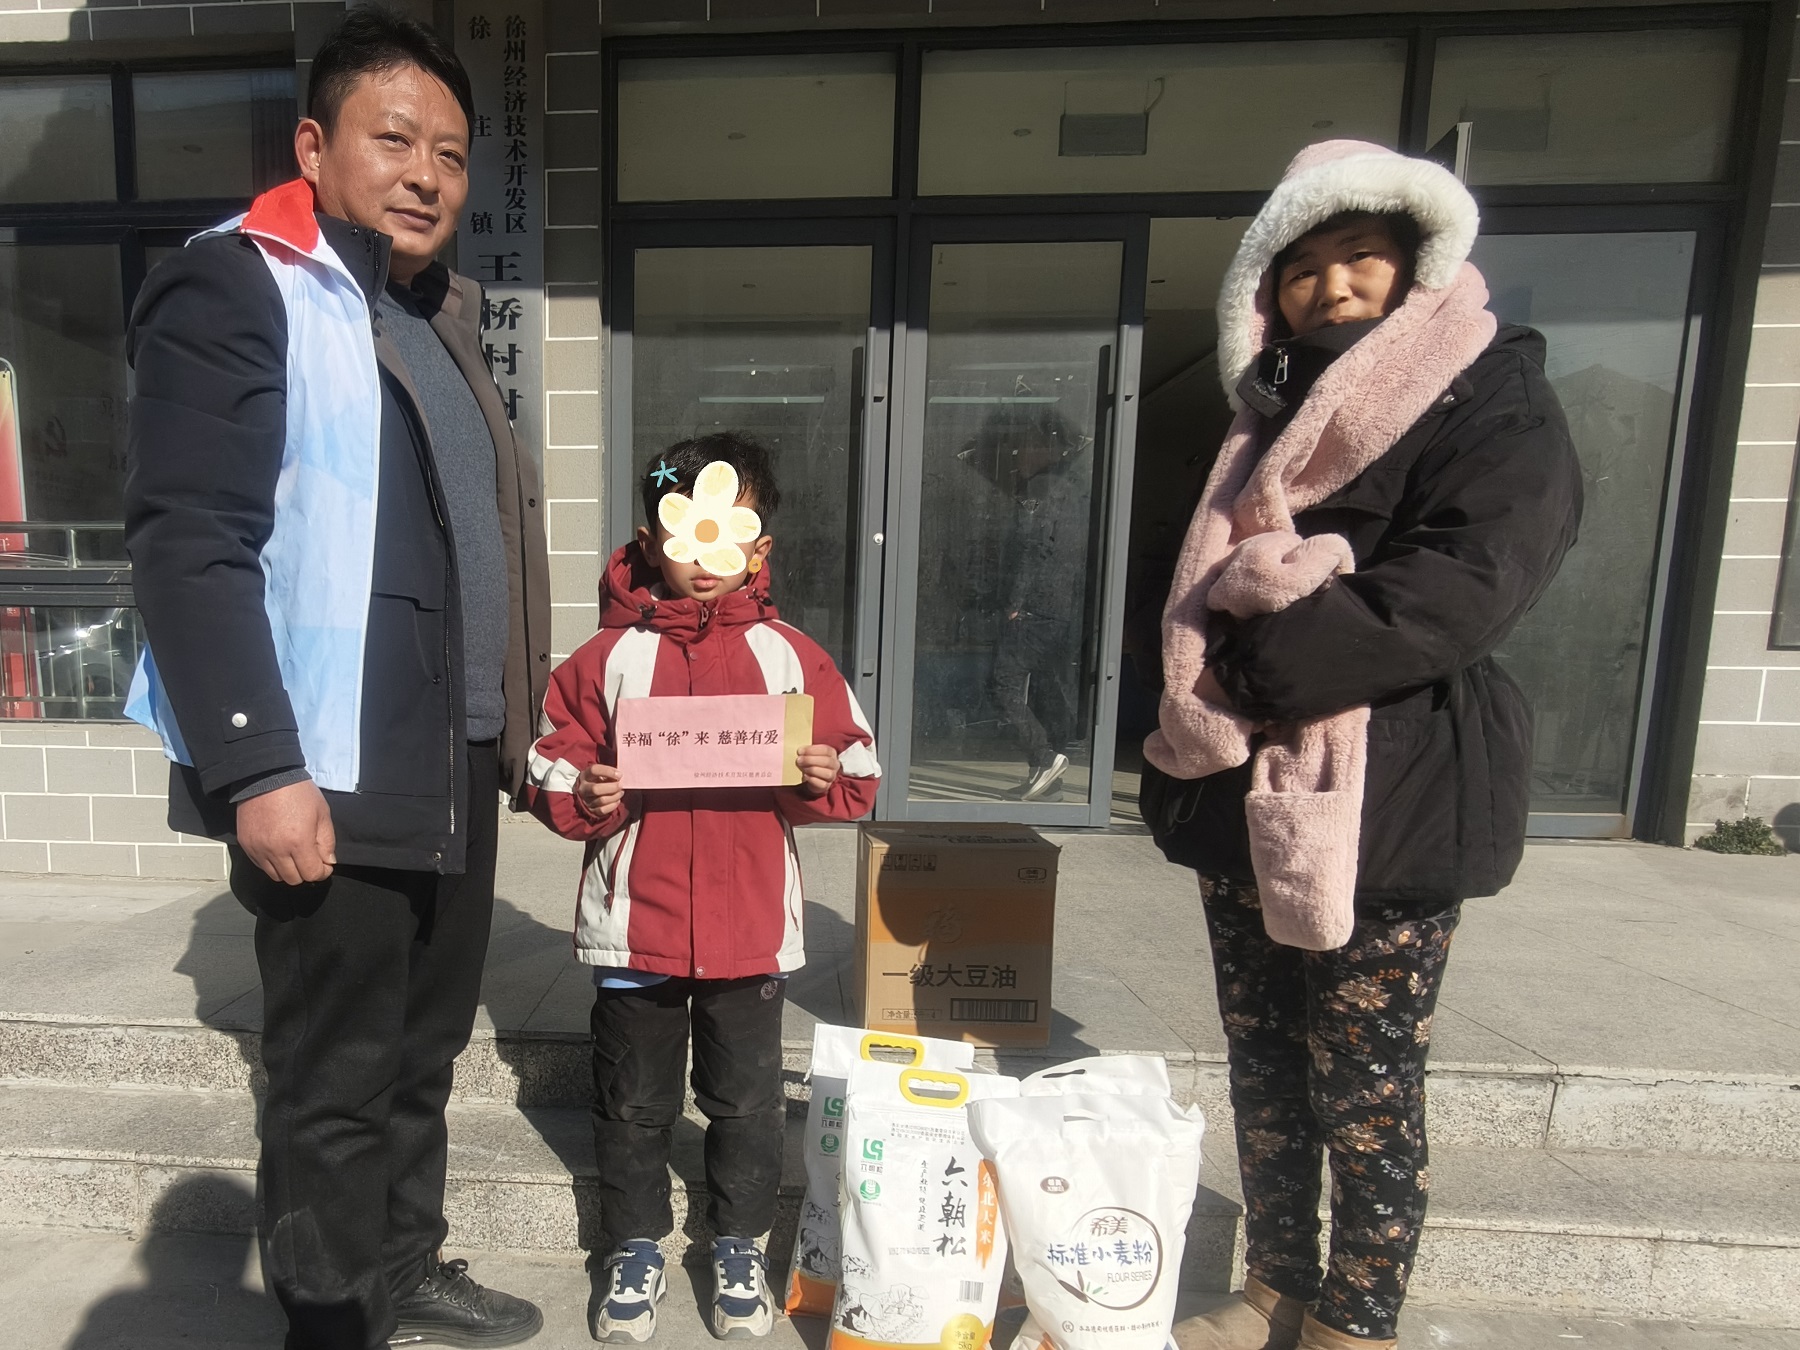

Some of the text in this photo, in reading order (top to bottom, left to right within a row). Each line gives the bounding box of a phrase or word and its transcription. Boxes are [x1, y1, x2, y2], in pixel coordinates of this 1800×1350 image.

[504, 15, 527, 234] 徐州经济技术开发区
[717, 729, 779, 746] 慈善有爱
[882, 963, 1017, 989] 一级大豆油
[933, 1156, 968, 1257] 六朝松
[1090, 1215, 1129, 1237] 希美
[1047, 1239, 1154, 1267] 标准小麦粉
[1107, 1269, 1153, 1283] FLOUR SERIES
